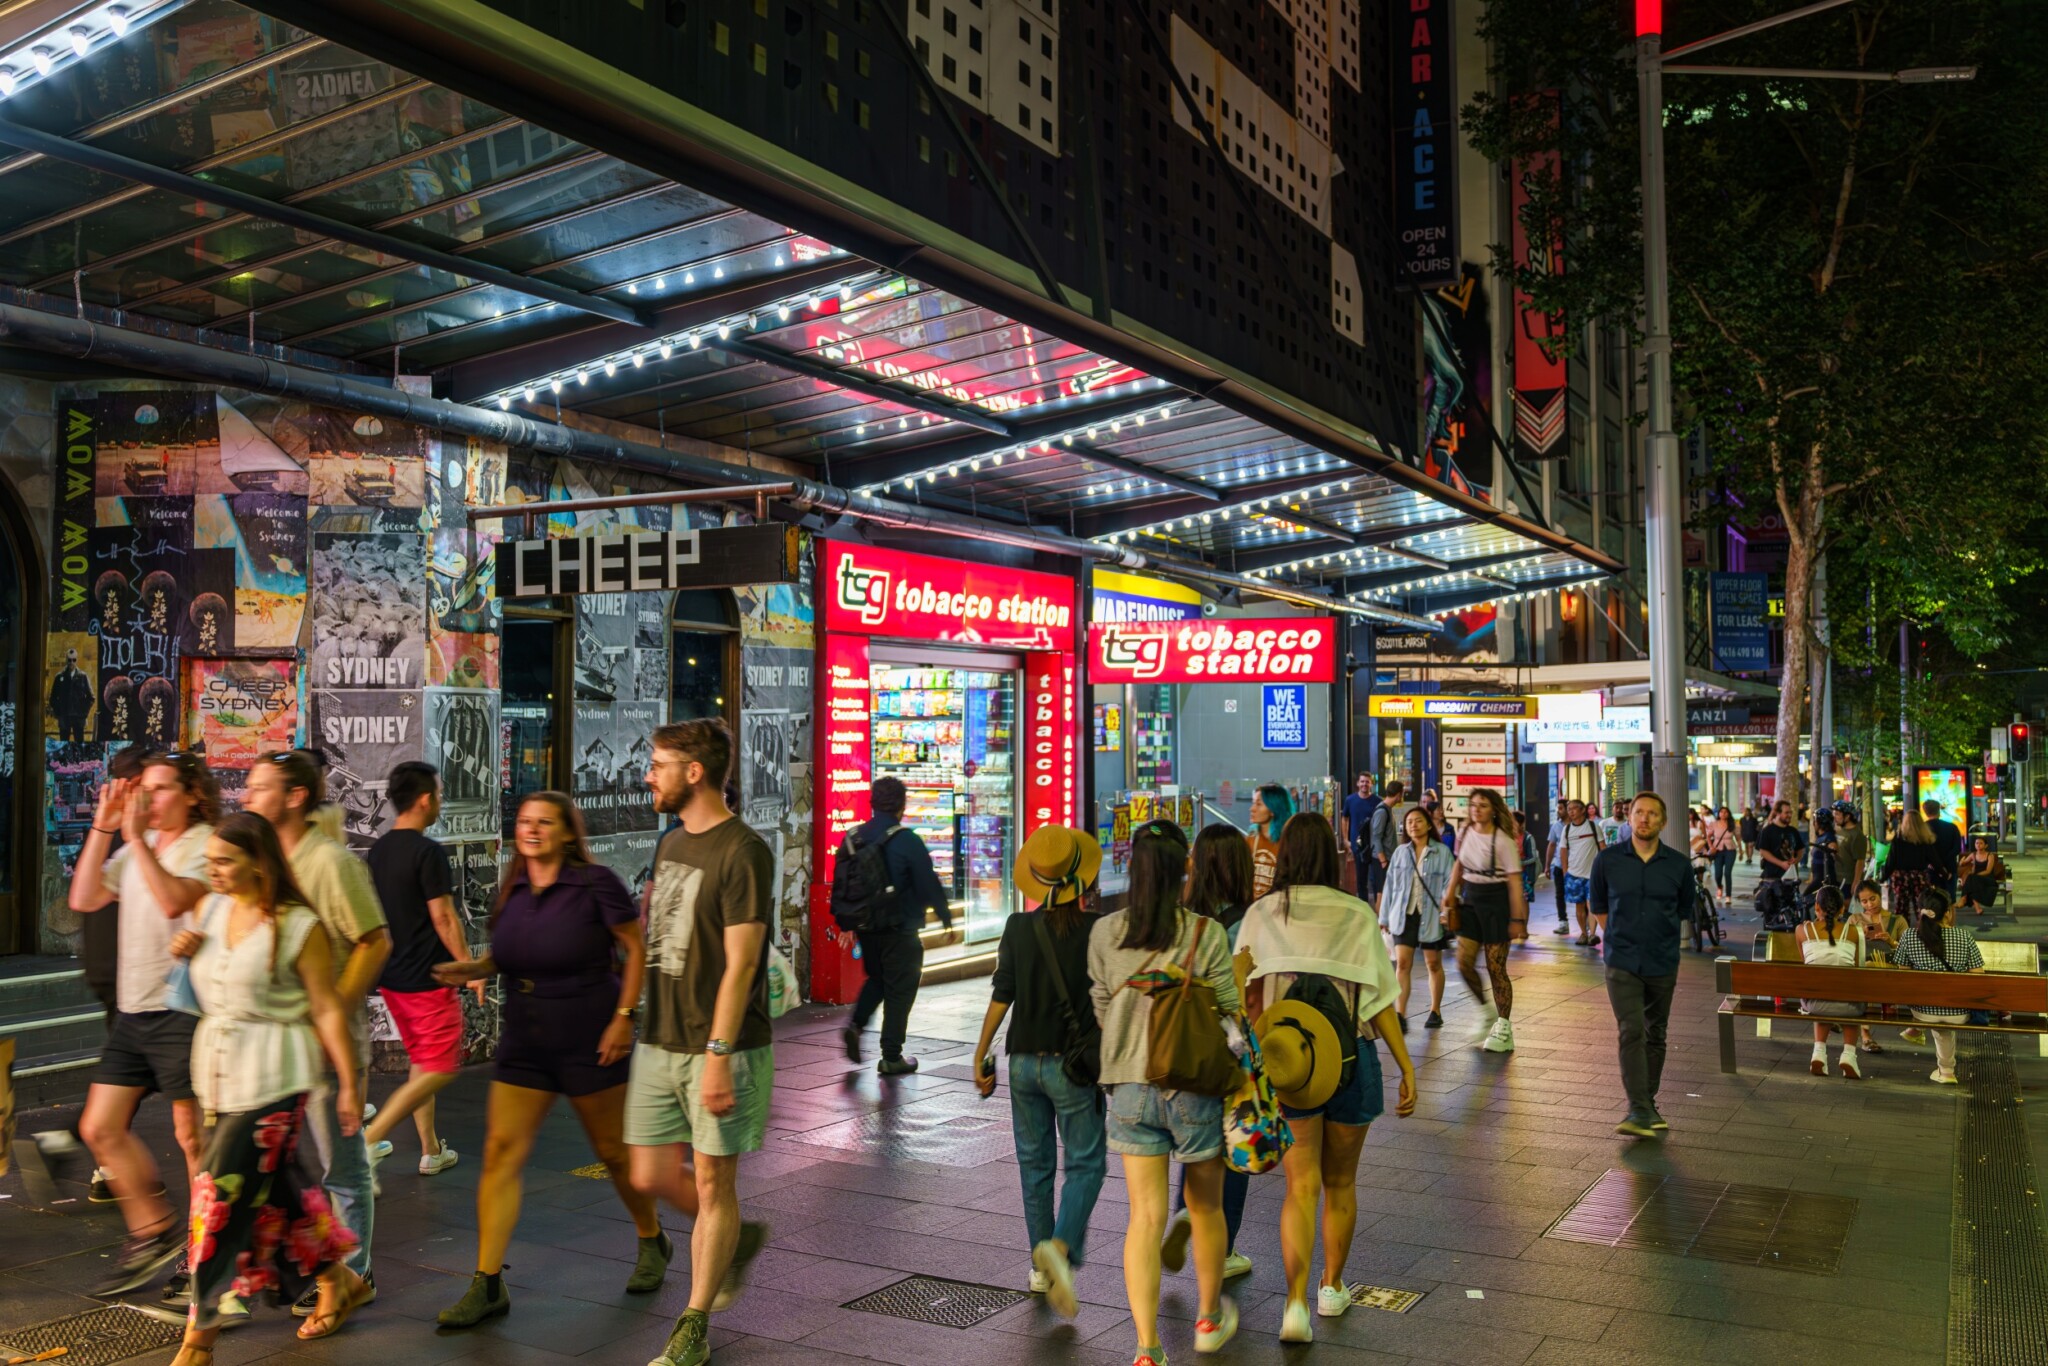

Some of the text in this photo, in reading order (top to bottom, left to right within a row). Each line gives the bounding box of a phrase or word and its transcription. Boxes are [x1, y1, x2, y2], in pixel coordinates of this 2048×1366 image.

[1412, 106, 1435, 211] ACE
[1401, 224, 1446, 243] OPEN
[1416, 242, 1436, 257] 24
[60, 408, 93, 613] WOW WOW
[256, 506, 300, 519] Welcome
[258, 529, 297, 543] Sydney
[515, 528, 700, 597] CHEEP
[581, 593, 627, 617] SYDNEY
[895, 578, 992, 620] tobacco
[997, 593, 1070, 628] station
[638, 610, 661, 623] SYDNEY
[1717, 614, 1735, 627] FOR
[1177, 625, 1322, 652] tobacco
[1185, 645, 1313, 674] station
[327, 657, 410, 685] SYDNEY
[748, 666, 784, 687] SYDNEY
[201, 697, 294, 711] SYDNEY
[432, 693, 494, 710] SYDNEY
[1273, 688, 1296, 706] WE
[577, 708, 611, 720] Sydney
[623, 708, 654, 719] Sydney
[1267, 704, 1302, 722] BEAT
[1428, 702, 1522, 713] DISCOUNT CHEMIST
[1687, 710, 1727, 721] ANZI
[325, 716, 409, 744] SYDNEY
[1036, 673, 1053, 786] tobacco
[1267, 729, 1302, 742] PRICES
[1693, 726, 1713, 735] Call
[1715, 725, 1740, 735] 0416
[1742, 725, 1761, 734] 490
[1445, 737, 1453, 748] 7
[1445, 759, 1453, 769] 6
[1063, 734, 1073, 829] Accesso
[1445, 779, 1453, 791] 5
[1445, 802, 1453, 813] 4
